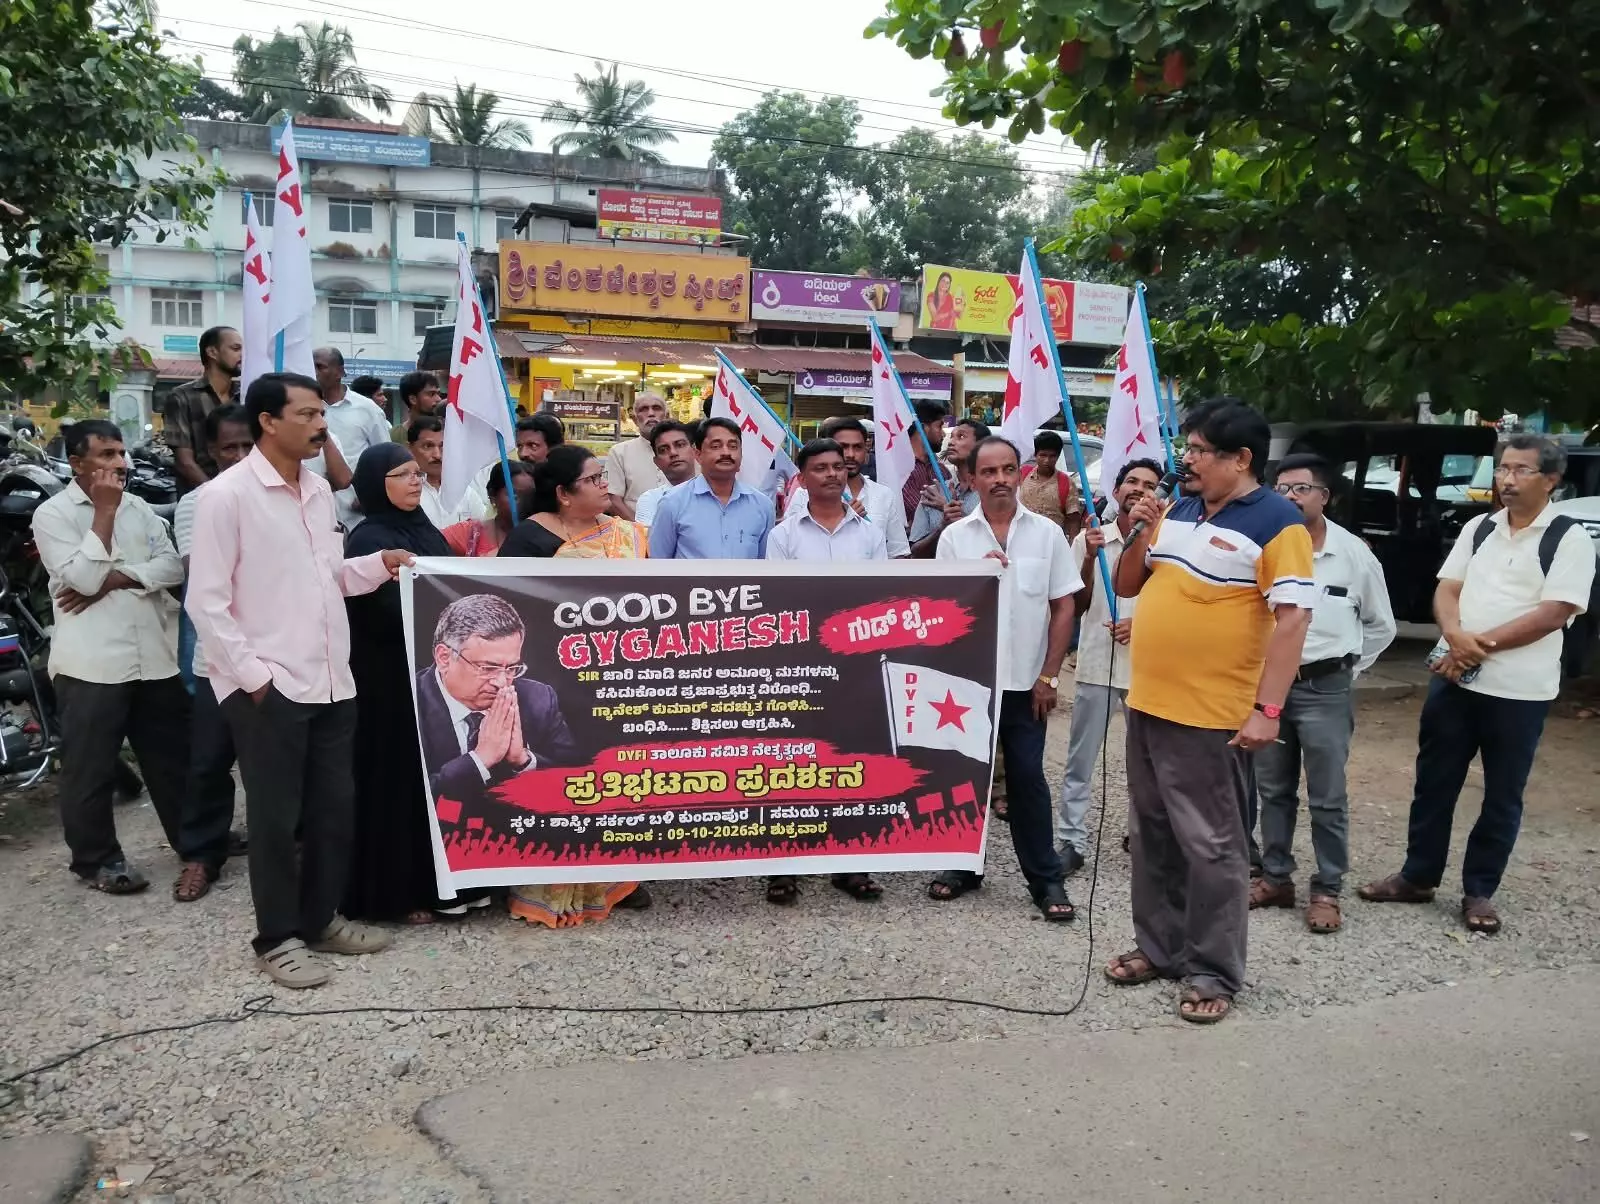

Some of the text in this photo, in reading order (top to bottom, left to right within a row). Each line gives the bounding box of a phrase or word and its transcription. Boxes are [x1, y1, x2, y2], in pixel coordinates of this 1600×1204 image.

[506, 250, 537, 301] ಶ್ರೀ
[803, 277, 852, 291] ಐಡಿಯಲ್
[826, 374, 866, 384] ಐಡಿಯಲ್
[553, 584, 763, 629] GOOD BYE
[848, 608, 898, 643] ಗುಡ್
[557, 609, 811, 670] GYGANESH
[577, 665, 840, 682] SIR ಜಾರಿ ಮಾಡಿ ಜನರ ಅಮೂಲ್ಯ ಮತಗಳನ್ನು
[595, 685, 678, 699] ಕಸಿದುಕೊಂಡ
[681, 684, 757, 700] ಪ್ರಜಾಪ್ರಭುತ್ವ
[592, 703, 649, 721] ಗ್ಯಾನೇಶ್
[652, 702, 708, 715] ಕುಮಾರ್
[711, 700, 763, 717] ಪದಚ್ಯುತ
[905, 672, 918, 734] DYFI
[691, 717, 738, 734] ಶಿಕ್ಷಿಸಲು
[617, 742, 816, 762] DYFI ತಾಲೂಕು ಸಮಿತಿ ನೇತೃತ್ವದಲ್ಲಿ
[564, 761, 865, 804] ಪ್ರತಿಭಟನಾ ಪ್ರದರ್ಶನ
[510, 815, 536, 834] ಸ್ಥಳ
[596, 813, 645, 827] ಸರ್ಕಲ್
[649, 810, 675, 825] ಬಳಿ
[678, 808, 749, 823] ಕುಂದಾಪುರ
[770, 805, 820, 819] ಸಮಯ
[832, 803, 864, 817] ಸಂಜೆ
[602, 828, 654, 842] ದಿನಾಂಕ
[667, 823, 767, 841] 09-10-2026ನೇ
[770, 821, 828, 839] ಶುಕ್ರವಾರ
